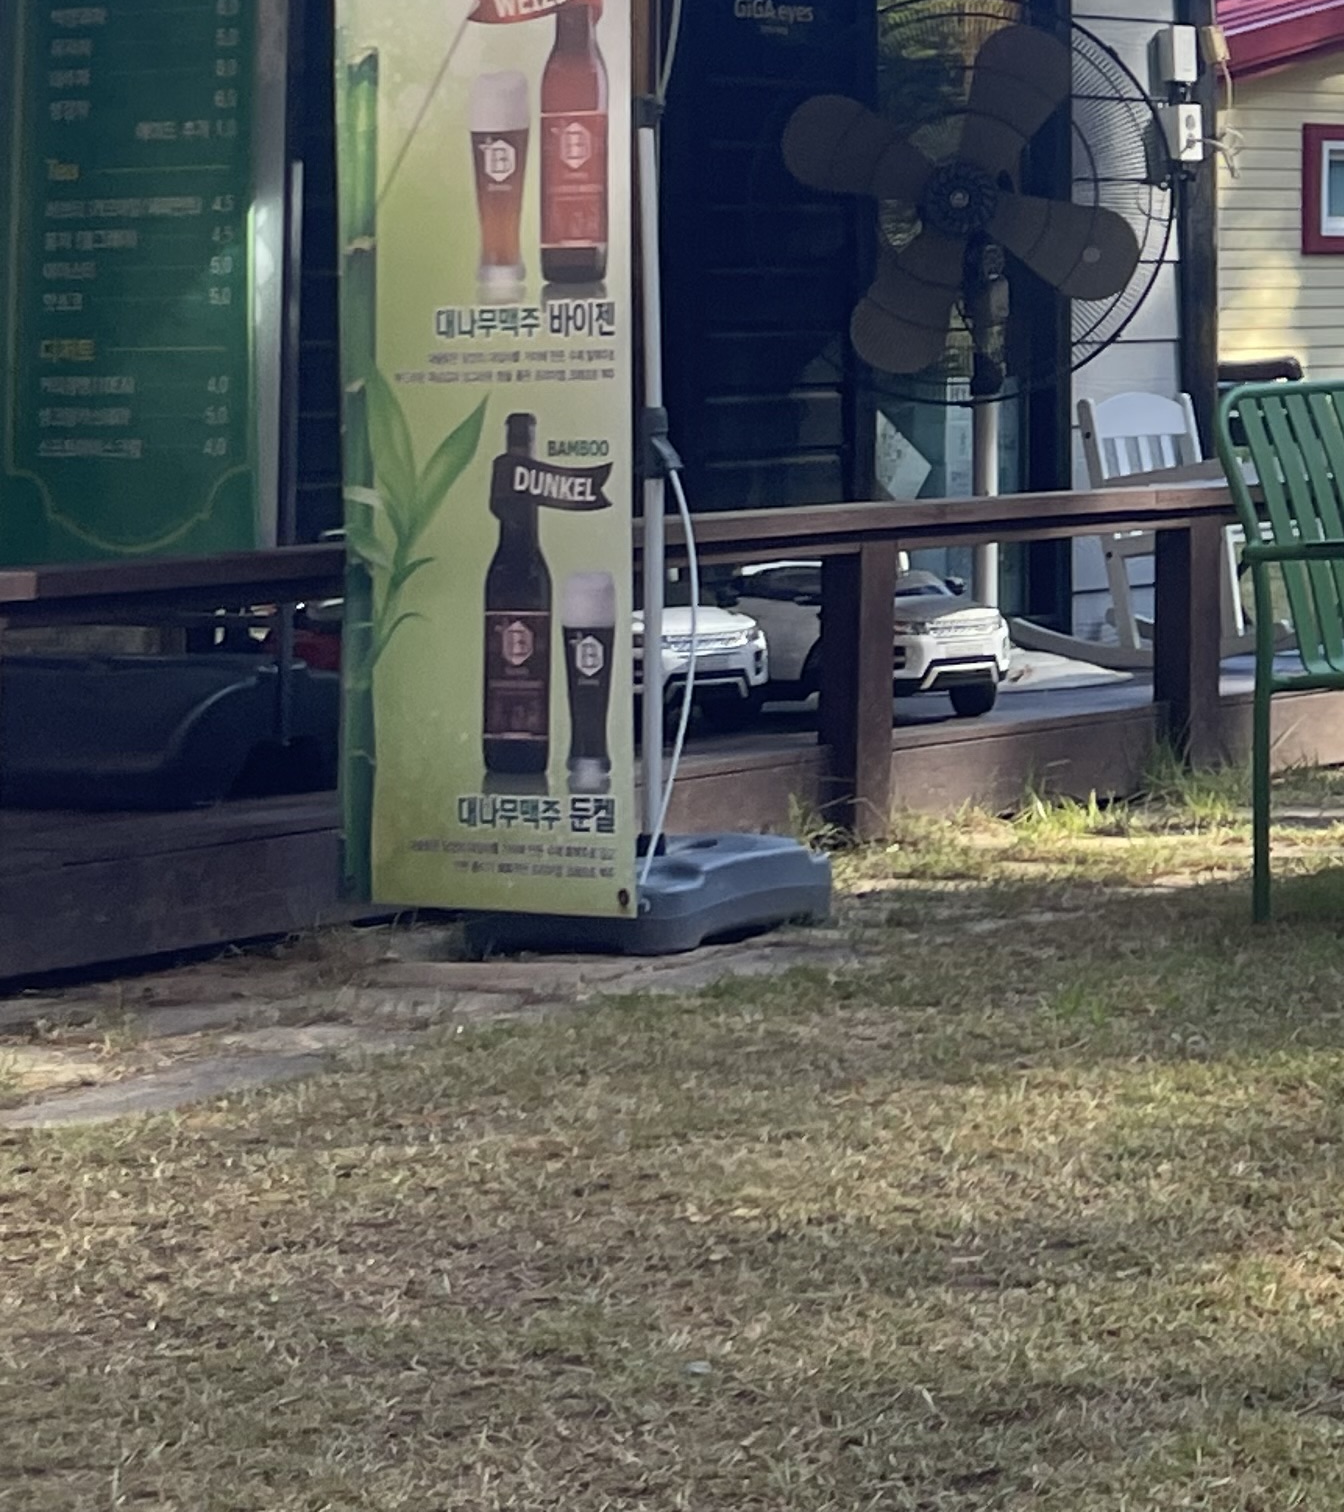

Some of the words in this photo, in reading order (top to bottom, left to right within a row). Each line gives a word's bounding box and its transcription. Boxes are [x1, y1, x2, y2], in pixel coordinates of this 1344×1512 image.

[435, 307, 541, 339] 대나무맥주
[549, 301, 616, 338] 바이젠
[547, 439, 609, 457] BAMBOO
[513, 465, 597, 502] DUNKEL
[458, 797, 561, 830] 대나무맥주
[569, 797, 615, 833] 둔켈
